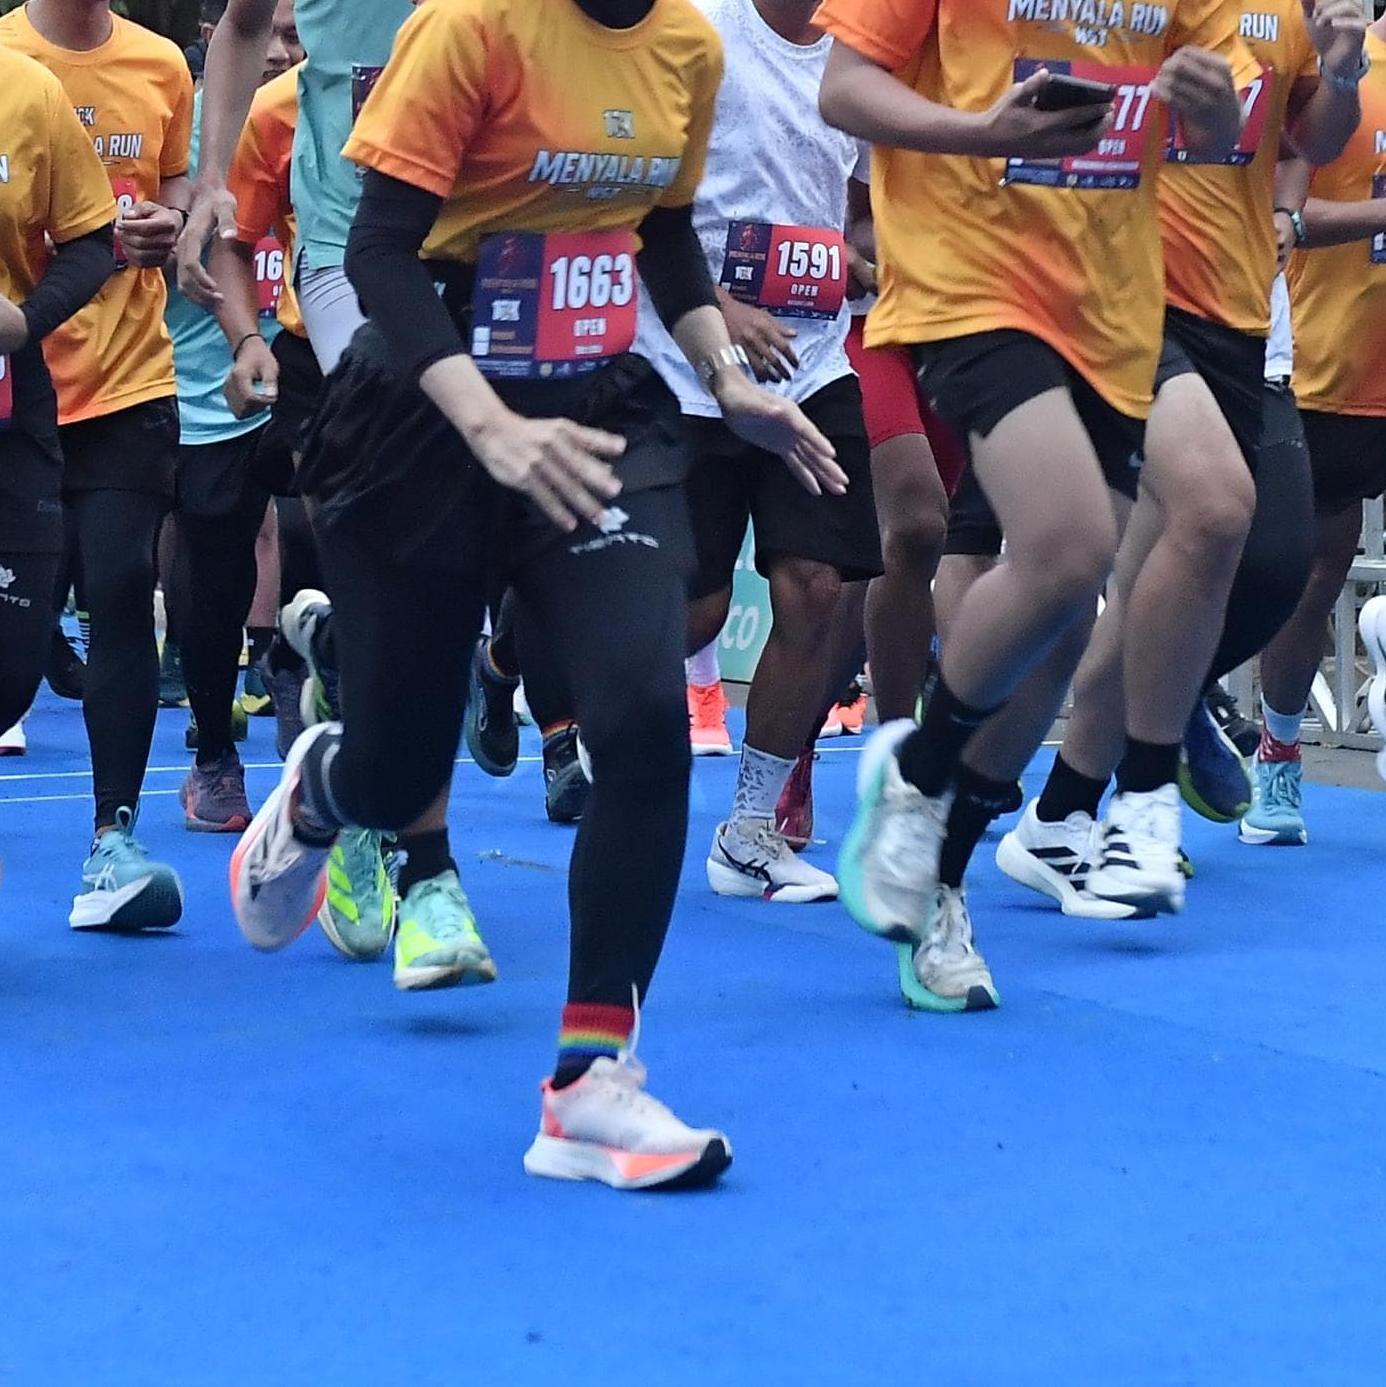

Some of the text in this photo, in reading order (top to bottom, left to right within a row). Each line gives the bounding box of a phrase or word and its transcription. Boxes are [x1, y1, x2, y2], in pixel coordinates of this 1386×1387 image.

[1129, 2, 1170, 36] RUN
[1239, 14, 1279, 42] RUN
[1115, 84, 1152, 131] 77
[109, 134, 142, 159] RUN
[528, 149, 645, 185] MENYALA
[255, 250, 283, 281] 16
[778, 241, 840, 280] 1591
[550, 253, 633, 310] 1663
[791, 284, 819, 297] OPEN
